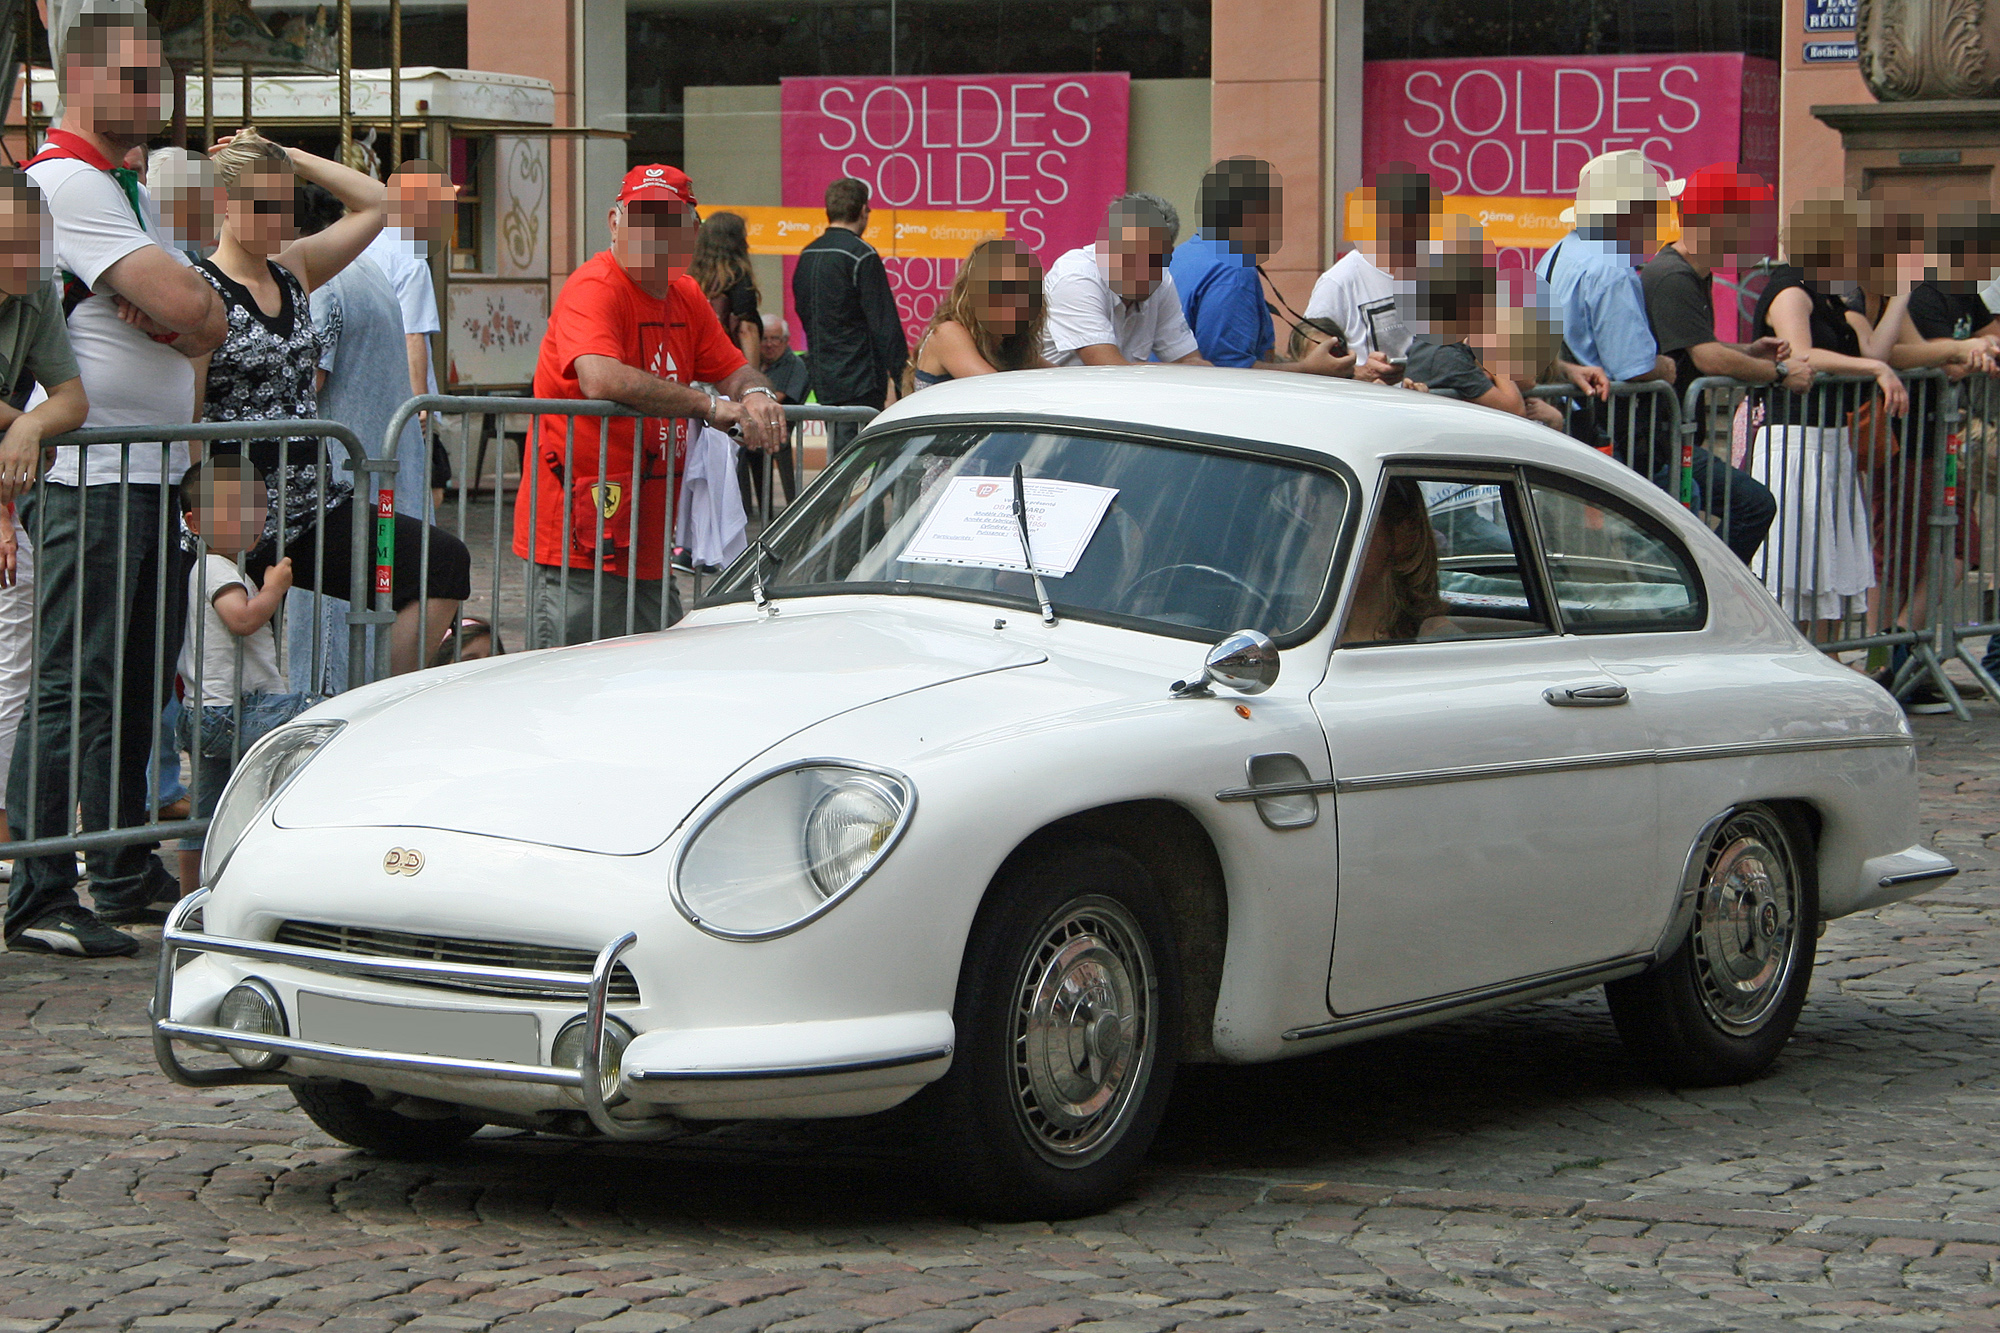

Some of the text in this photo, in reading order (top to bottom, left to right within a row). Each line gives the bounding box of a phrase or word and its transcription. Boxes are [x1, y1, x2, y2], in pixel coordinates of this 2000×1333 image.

[1810, 13, 1855, 27] RÉUNI
[1404, 65, 1700, 138] SOLDES
[819, 82, 1091, 150] SOLDES
[842, 150, 1068, 207] SOLDES
[1479, 210, 1516, 228] 2ème
[777, 220, 811, 237] 2ème
[895, 223, 928, 239] 2ème
[382, 503, 392, 512] M
[380, 578, 390, 587] M
